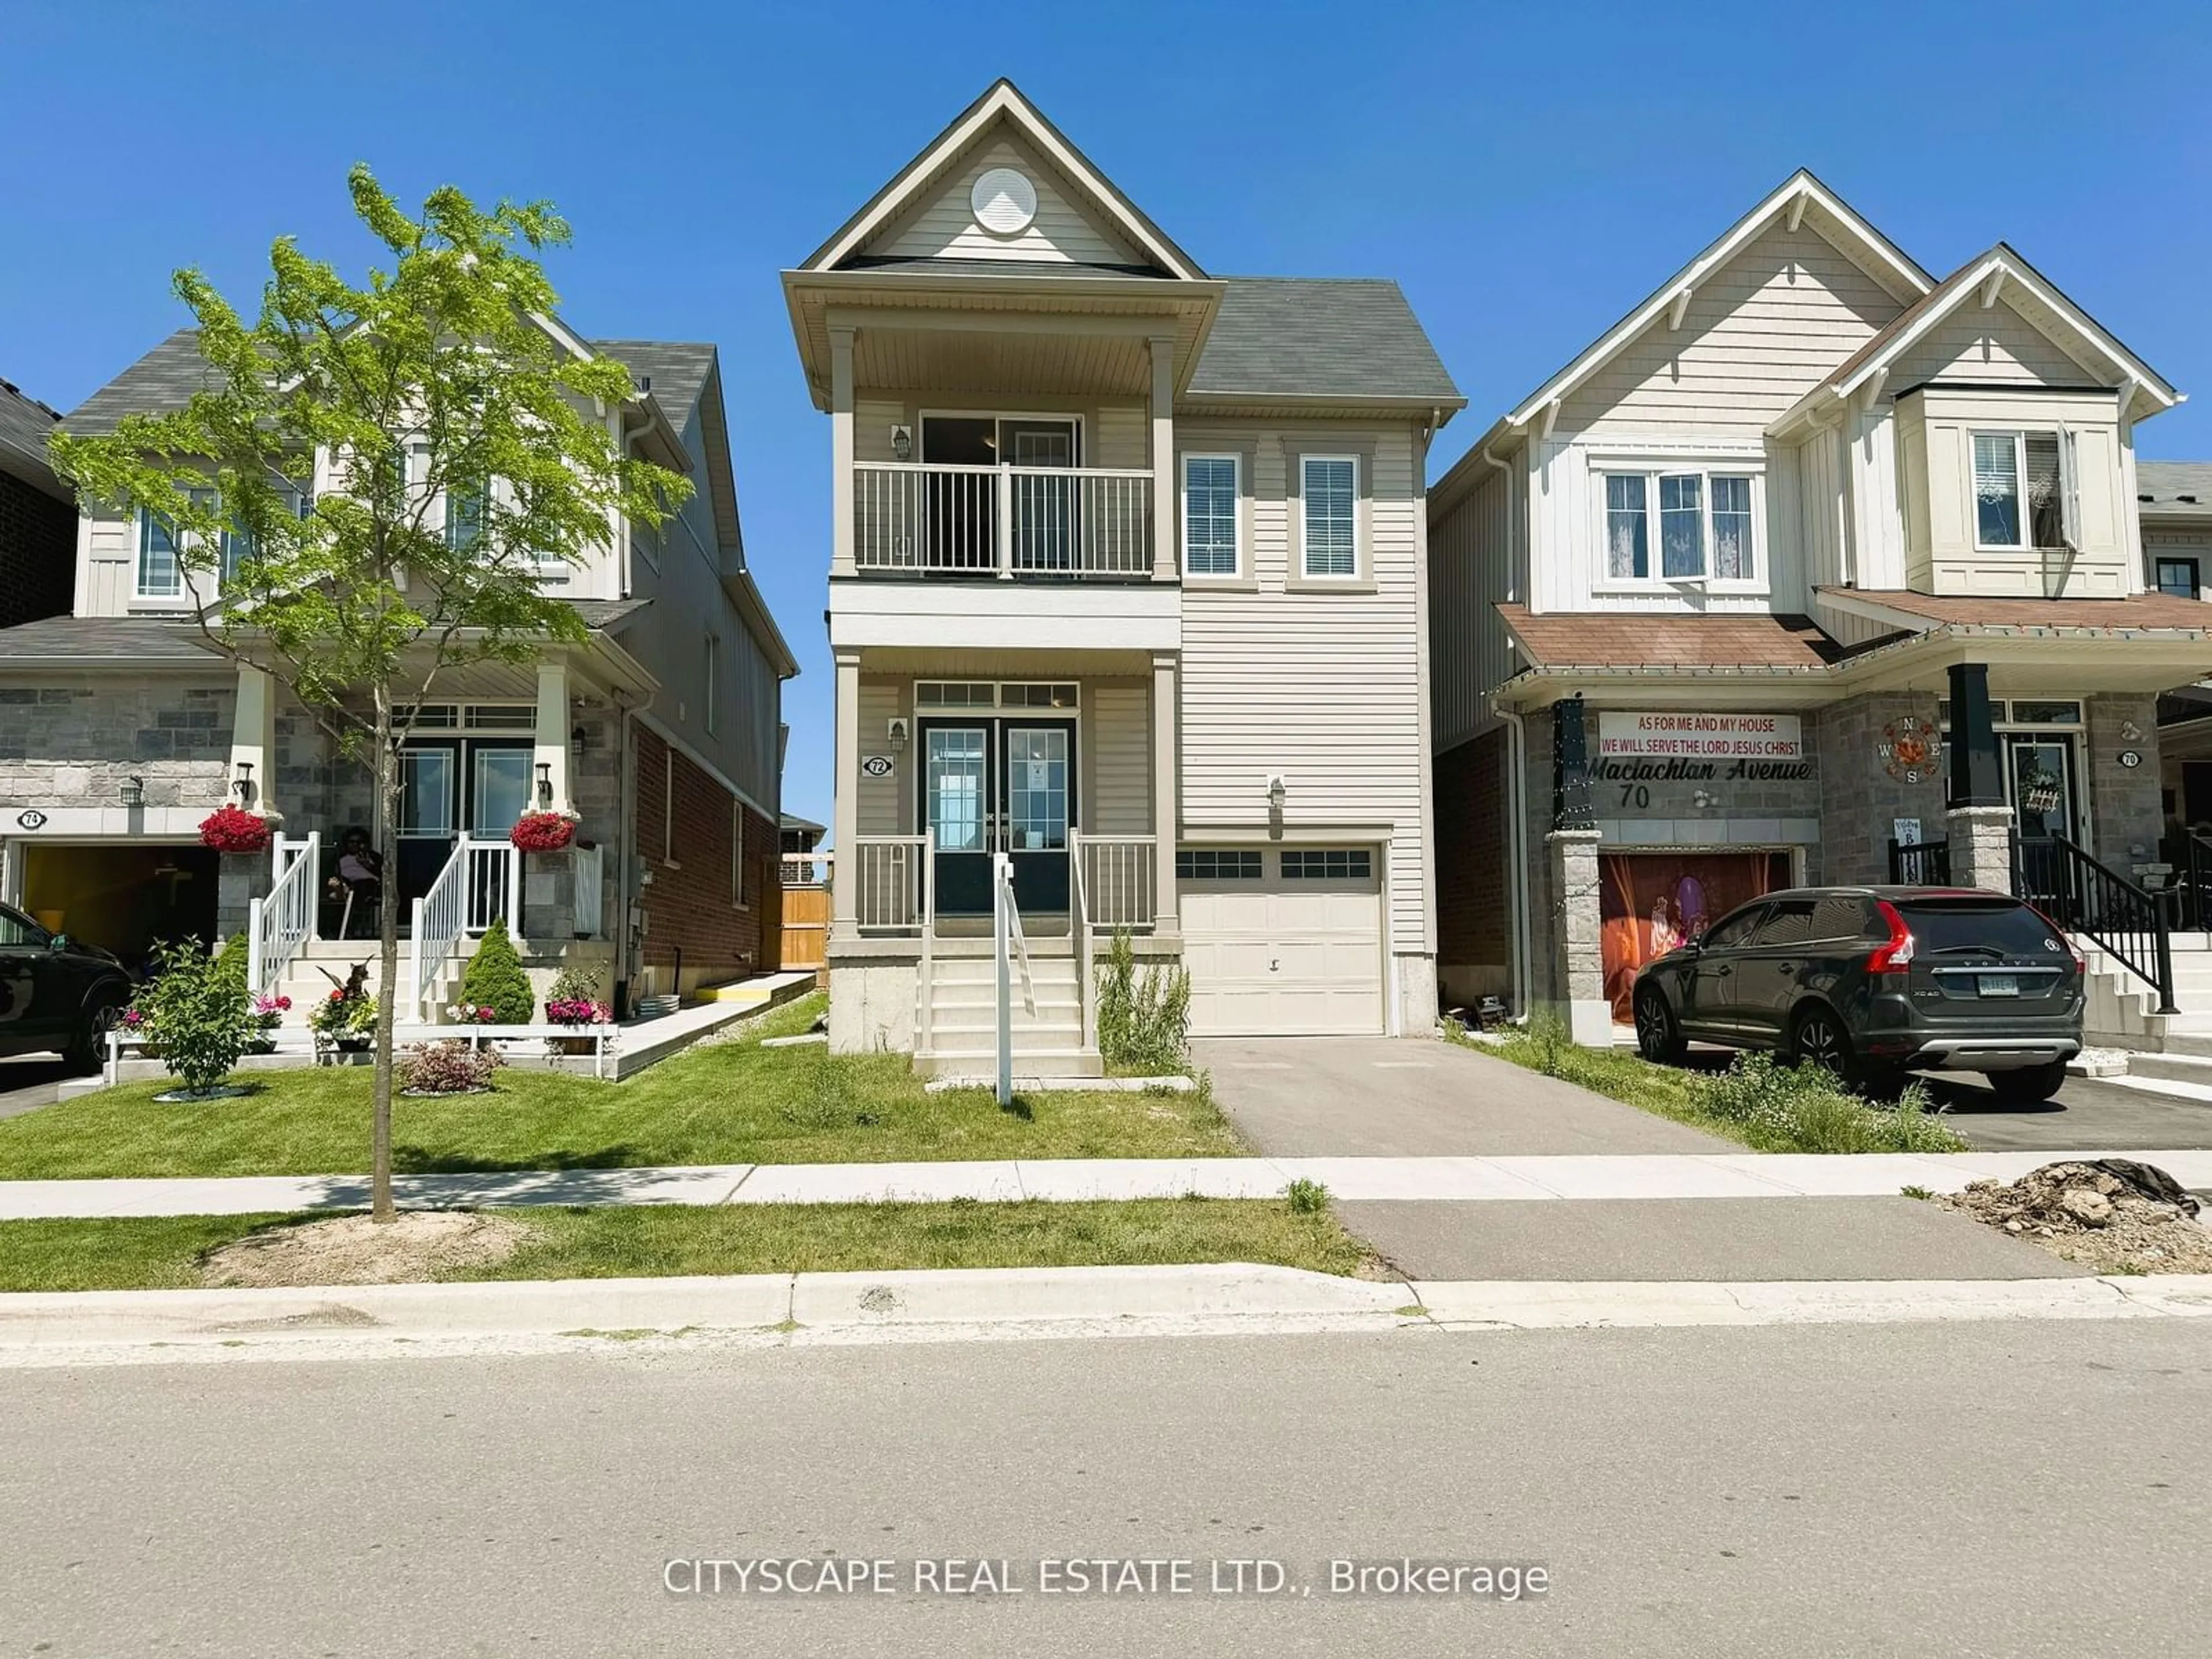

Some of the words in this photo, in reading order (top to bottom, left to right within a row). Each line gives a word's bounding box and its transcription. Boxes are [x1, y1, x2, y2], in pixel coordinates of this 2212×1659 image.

[1639, 717, 1652, 730] AS
[1654, 717, 1676, 730] FOR
[1677, 717, 1692, 730] ME
[1695, 718, 1717, 731] AND
[1720, 718, 1736, 732] MY
[1739, 719, 1775, 732] HOUSE
[1603, 738, 1617, 752] WE
[1619, 738, 1645, 752] WILL
[1646, 740, 1677, 753] SERVE
[1679, 740, 1700, 753] THE
[1702, 741, 1729, 754] LORD
[1731, 741, 1762, 754] JESUS
[1764, 741, 1800, 755] CHRIST
[873, 762, 884, 771] 72
[2125, 755, 2135, 764] 70
[1588, 757, 1716, 781] Maclachlan
[1725, 759, 1812, 781] Avenue
[1620, 784, 1650, 808] 70
[26, 814, 37, 824] 74
